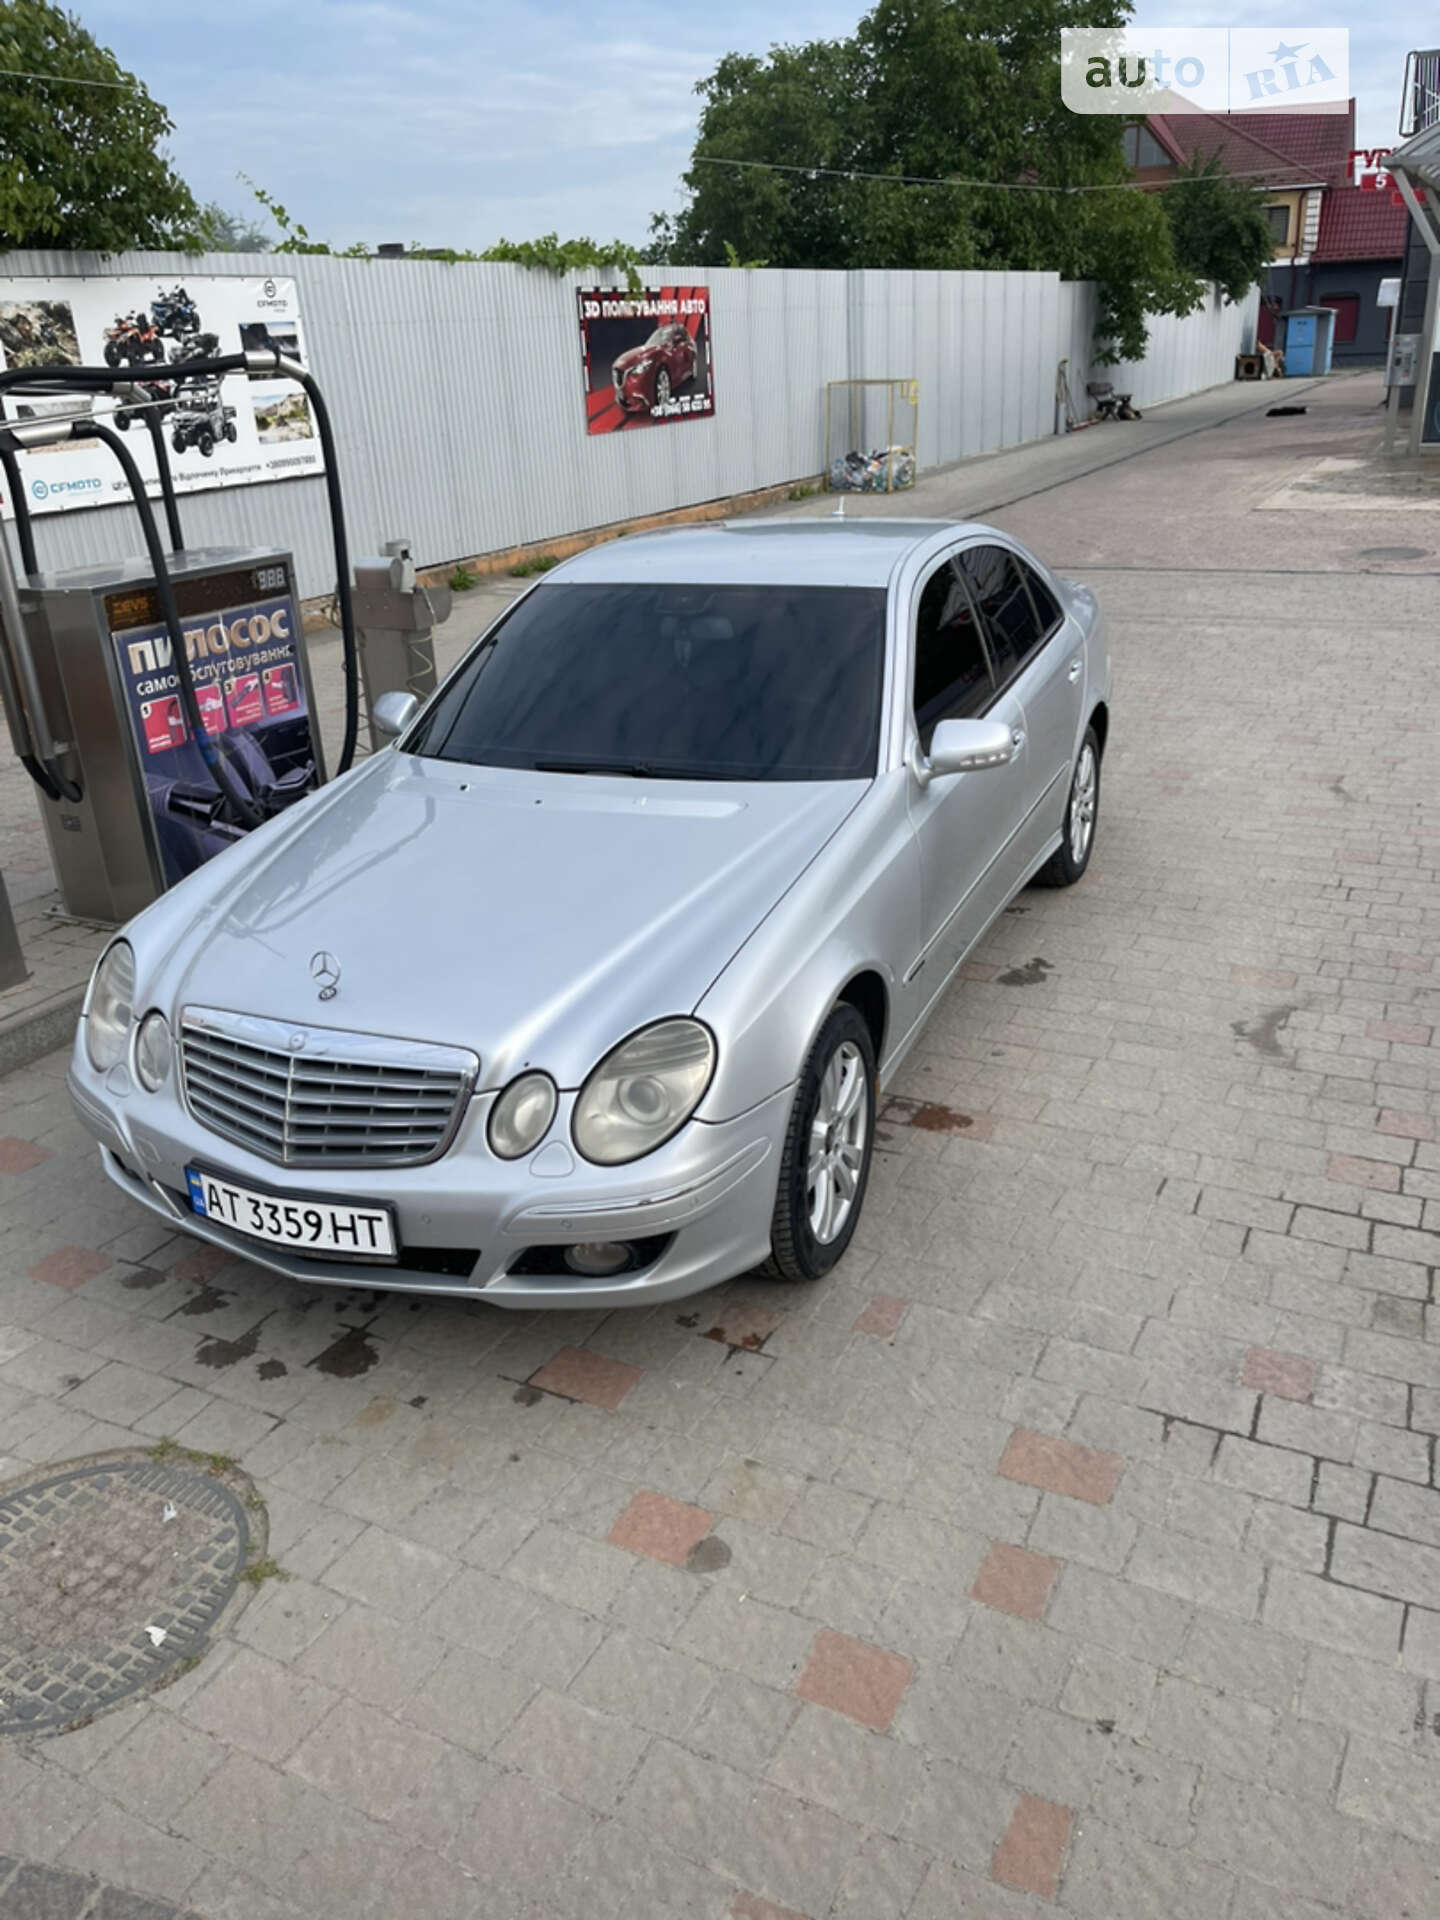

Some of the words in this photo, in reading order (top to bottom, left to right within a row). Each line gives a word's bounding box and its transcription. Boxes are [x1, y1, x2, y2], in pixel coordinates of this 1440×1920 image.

[584, 300, 600, 318] 3D
[681, 299, 705, 314] АВТО
[50, 478, 102, 493] CFMOTO
[127, 609, 289, 675] ПИЛОСОС
[136, 645, 294, 696] самослуговуванн
[207, 1183, 240, 1222] AT
[247, 1198, 322, 1241] 3359
[330, 1212, 382, 1247] HT
